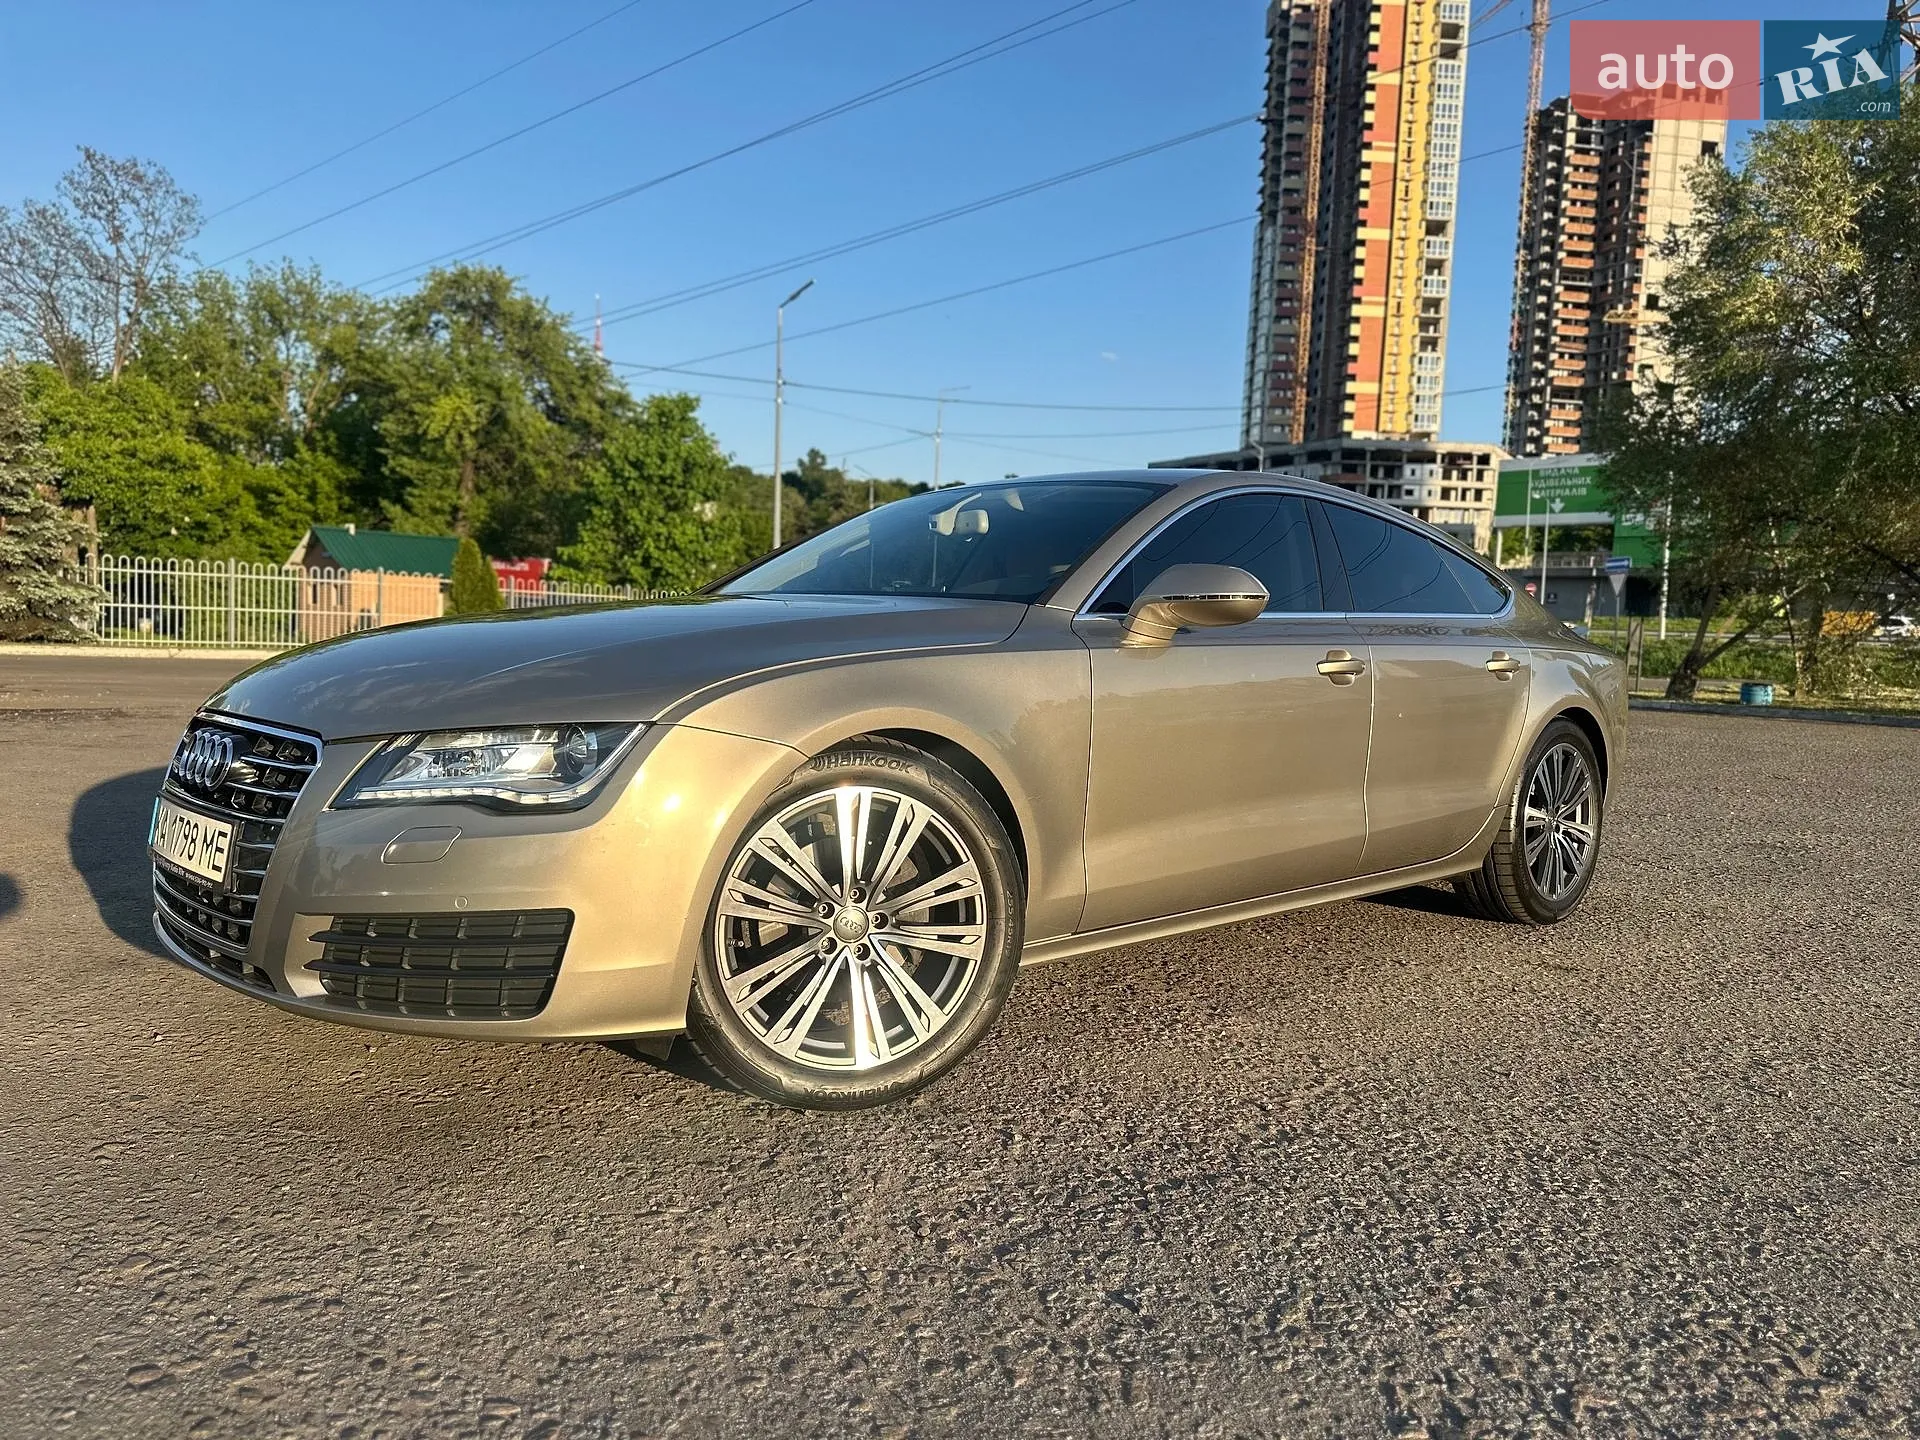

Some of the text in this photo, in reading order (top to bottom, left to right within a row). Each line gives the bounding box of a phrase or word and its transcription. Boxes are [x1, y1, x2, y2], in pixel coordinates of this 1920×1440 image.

[1540, 467, 1580, 477] ВИДАЧА
[170, 814, 198, 861] 1798
[200, 826, 228, 873] ME
